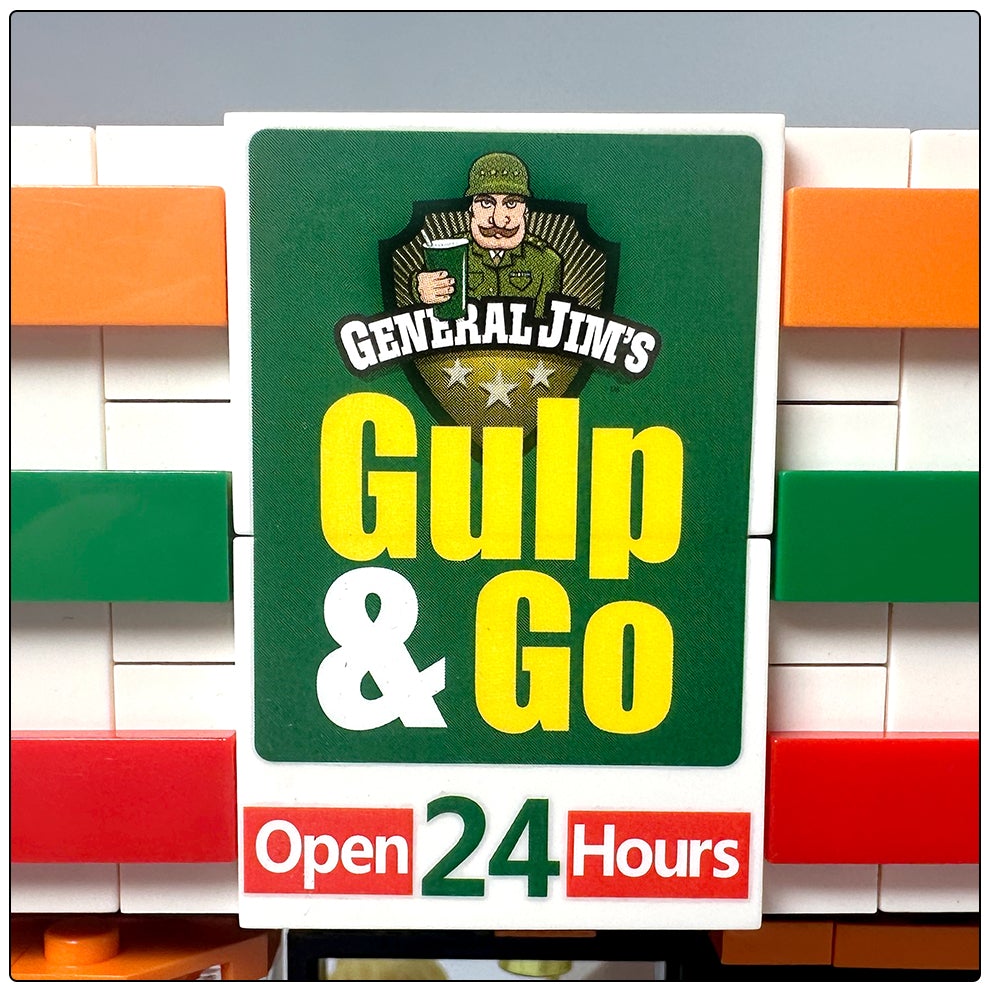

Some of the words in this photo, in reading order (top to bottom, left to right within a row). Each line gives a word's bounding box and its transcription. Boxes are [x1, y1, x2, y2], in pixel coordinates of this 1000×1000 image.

[340, 302, 534, 371] GENERAL
[537, 300, 656, 374] JIM'S
[320, 392, 685, 579] Gulp
[315, 566, 447, 729] &
[475, 570, 674, 734] Go
[255, 819, 409, 890] Open
[421, 795, 560, 897] 24
[572, 823, 740, 879] Hours
